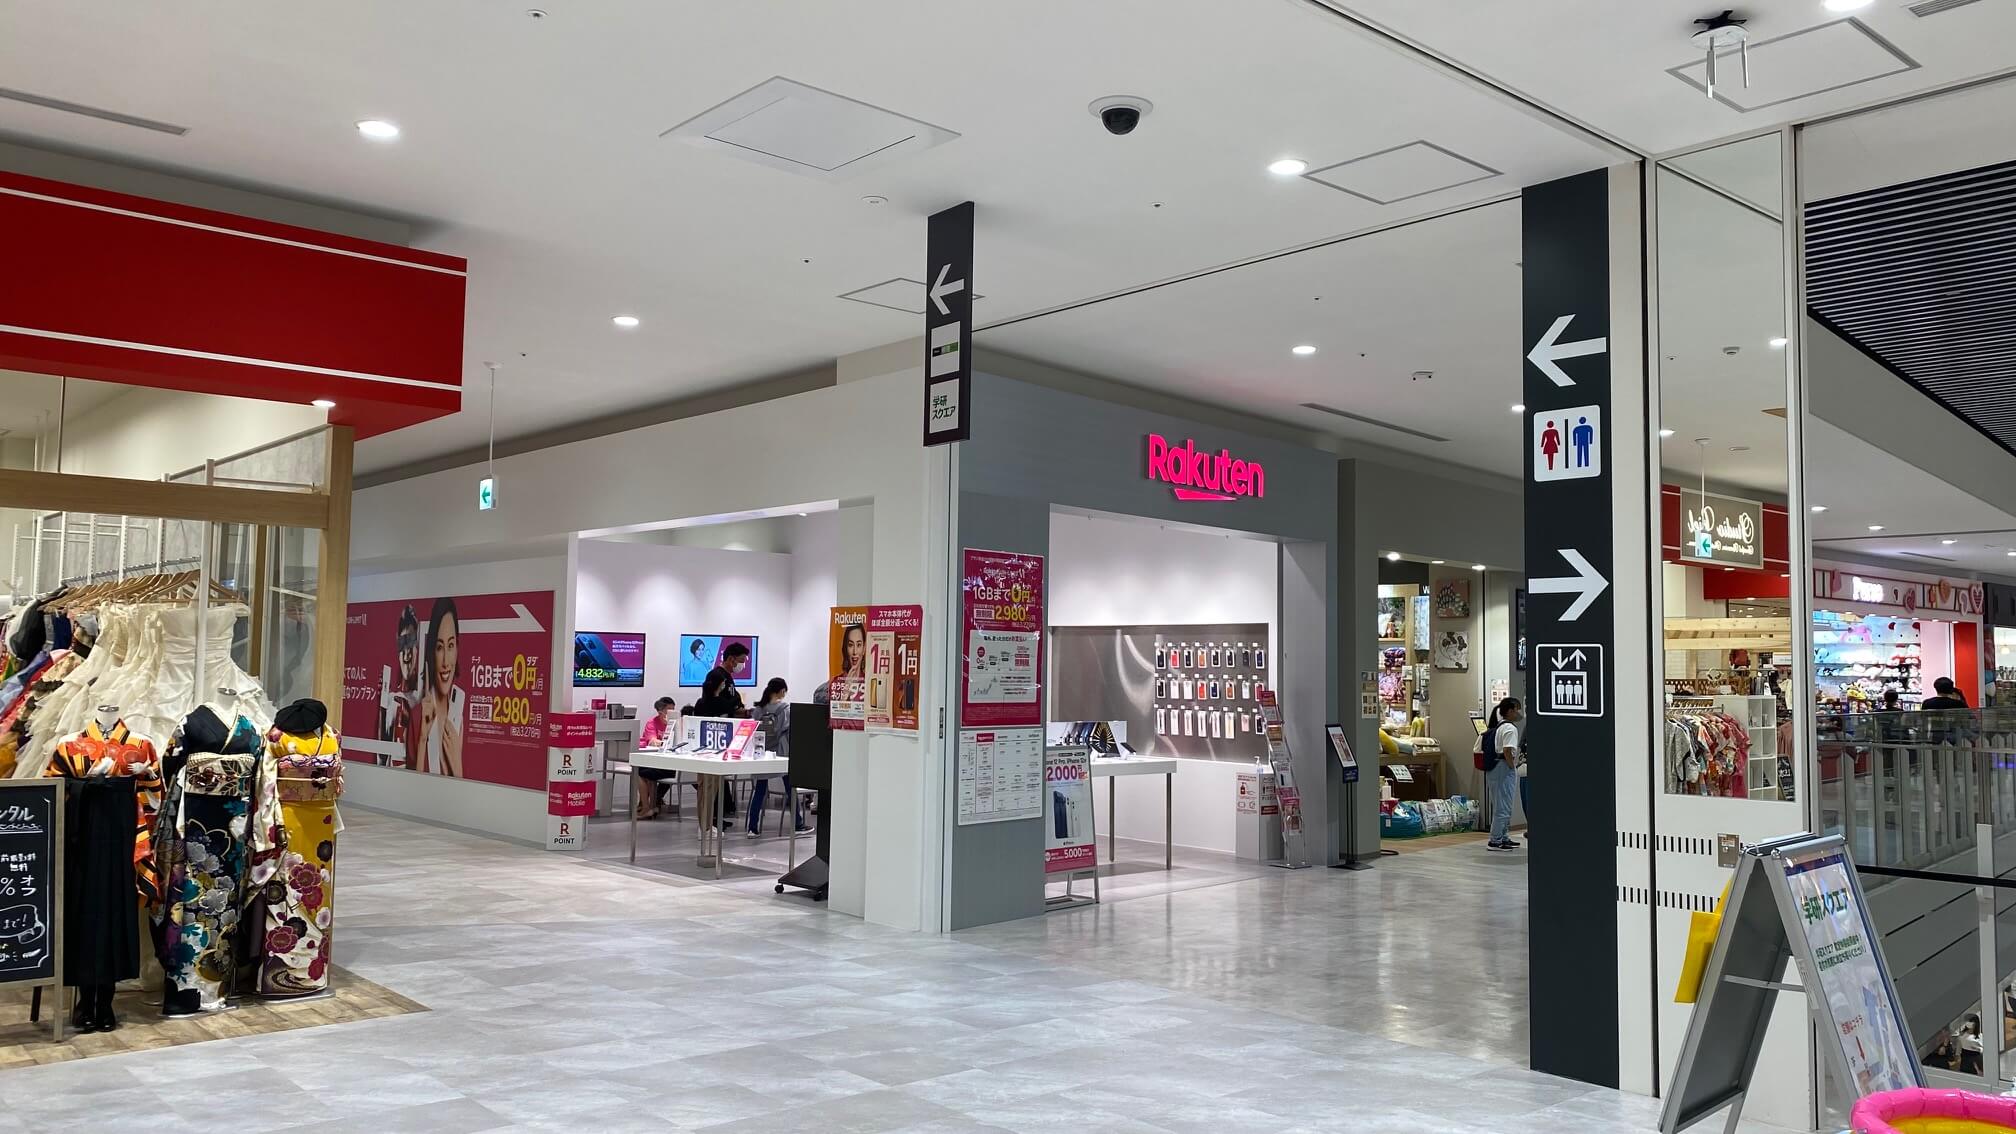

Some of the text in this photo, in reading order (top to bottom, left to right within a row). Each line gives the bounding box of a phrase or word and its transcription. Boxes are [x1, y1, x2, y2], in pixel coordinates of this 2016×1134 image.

[932, 393, 947, 409] 学研
[932, 405, 956, 421] スクエア
[1149, 433, 1264, 499] Rakuten
[834, 611, 866, 627] Rakuten
[706, 731, 727, 750] BIG
[563, 754, 572, 767] R
[567, 792, 592, 800] Rakuten
[560, 822, 570, 836] R
[554, 837, 575, 845] POINT
[20, 874, 37, 897] オフ
[3, 914, 27, 930] まで!
